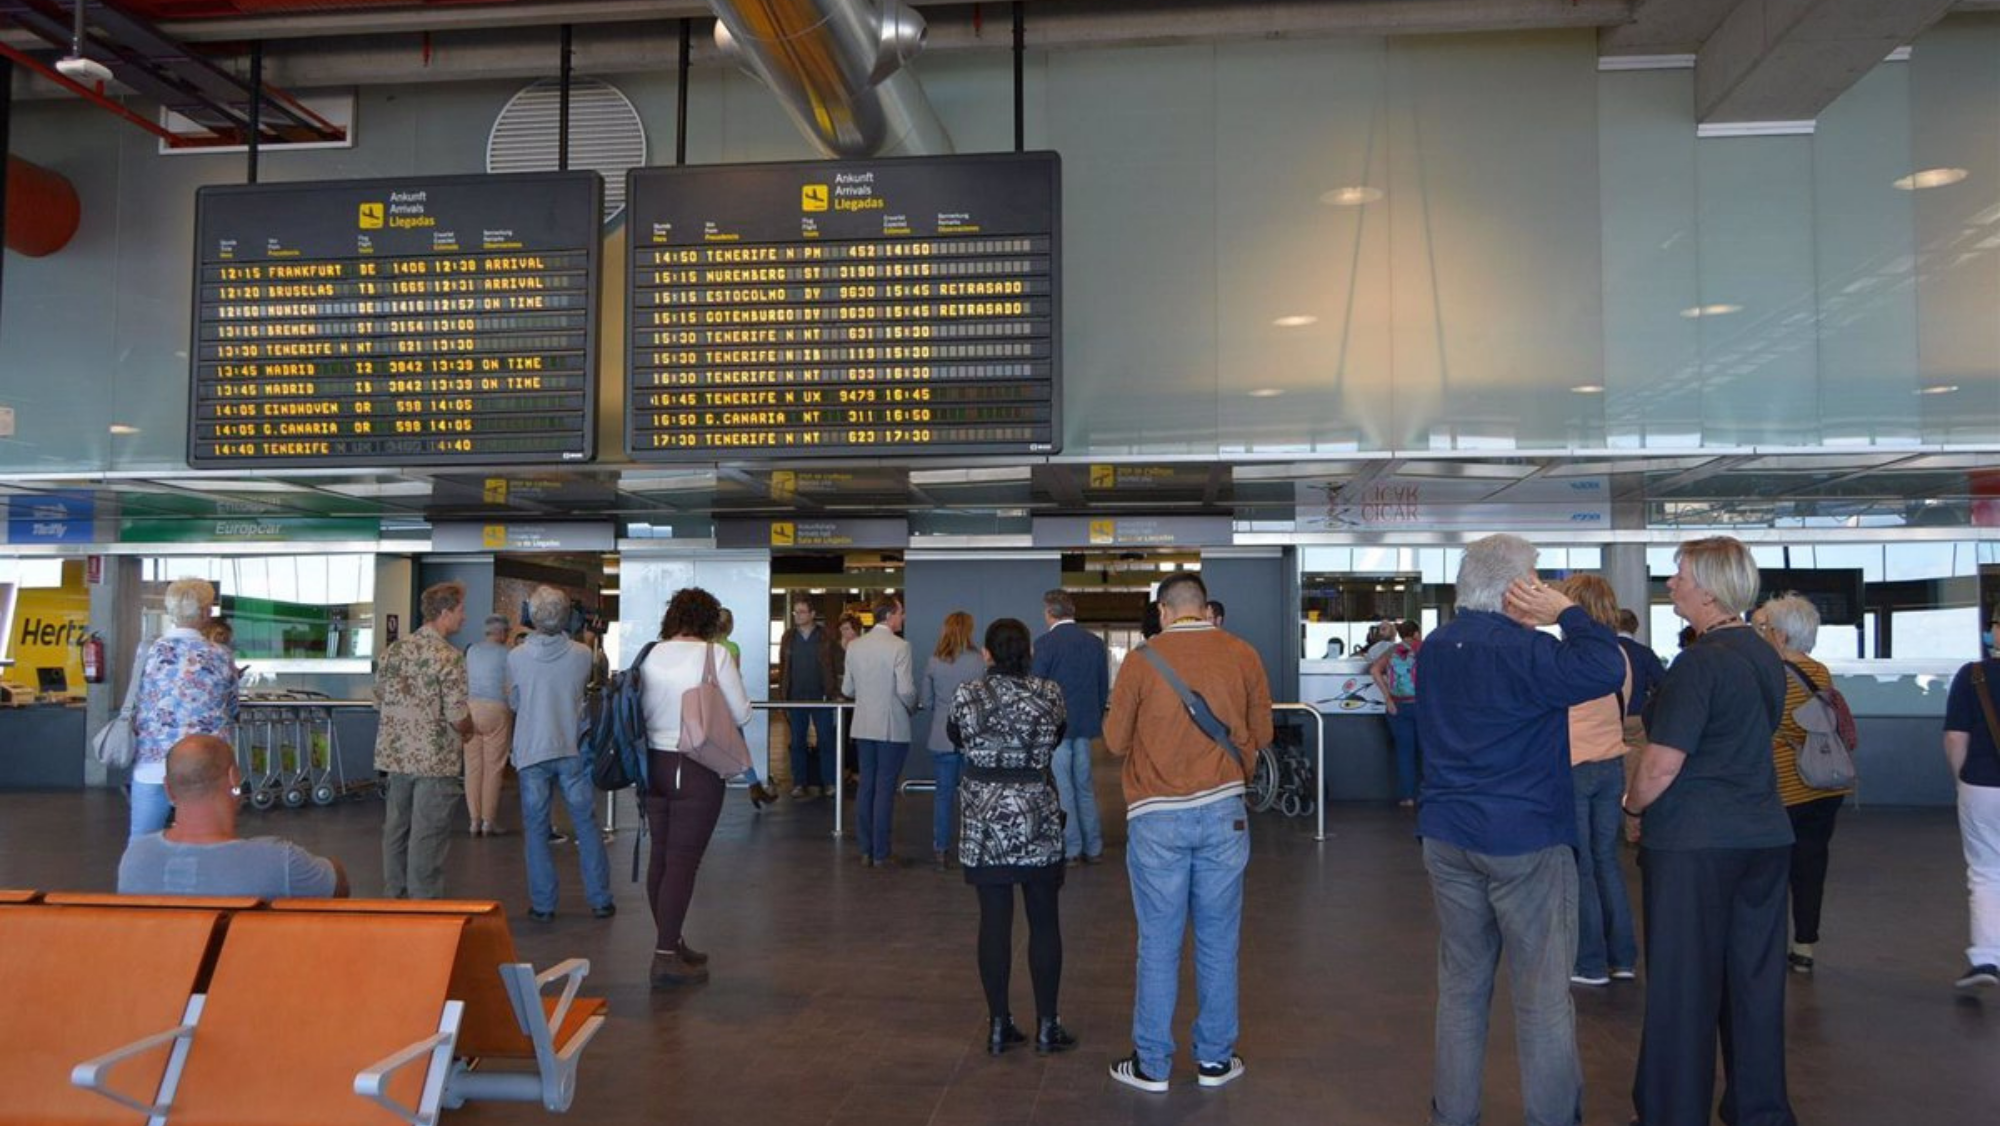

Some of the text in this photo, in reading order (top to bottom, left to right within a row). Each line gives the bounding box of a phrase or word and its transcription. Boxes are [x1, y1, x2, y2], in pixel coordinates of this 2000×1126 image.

[835, 171, 874, 183] Ankunft
[390, 191, 427, 202] Ankunft
[835, 185, 872, 196] Arrivals
[390, 203, 424, 214] Arrivals
[835, 198, 884, 212] Llegadas
[390, 215, 435, 228] Llegadas
[654, 243, 929, 263] 14:50 TENERIFE N PM 452 14:50
[221, 268, 261, 280] 12:15
[269, 264, 341, 278] FRANKFURT
[360, 263, 376, 276] DE
[485, 257, 544, 271] ARRIVAL
[654, 271, 697, 284] 15:15
[706, 268, 786, 282] NUREMBERG
[804, 267, 820, 280] ST
[886, 264, 930, 276] 15:15
[220, 287, 259, 299] 12:20
[269, 284, 334, 298] BRUSELAS
[434, 279, 474, 292] 12:31
[485, 277, 543, 290] ARRIVAL
[654, 292, 697, 304] 15:15
[706, 288, 786, 303] ESTOCOLMO
[804, 287, 821, 300] DY
[886, 284, 930, 297] 15:45
[939, 281, 1022, 295] RETRASADO
[267, 303, 317, 317] MUNICH
[484, 297, 500, 309] ON
[510, 296, 543, 308] TIME
[654, 312, 697, 324] 15:15
[706, 308, 794, 323] GOTEMBURGO
[804, 308, 820, 320] DY
[886, 305, 930, 318] 15:45
[939, 302, 1022, 316] RETRASADO
[267, 323, 316, 336] BREMEN
[358, 321, 373, 333] ST
[654, 325, 930, 344] 15:30 TENERIFE N NT 631 15:30
[218, 339, 474, 357] 13:30 TENERIFE N NT 621 13:30
[654, 352, 697, 365] 15:30
[706, 349, 777, 363] TENERIFE
[786, 349, 794, 361] N
[886, 346, 930, 358] 15:30
[217, 365, 258, 377] 13:45
[265, 363, 315, 376] MADRID
[482, 358, 499, 370] ON
[508, 357, 541, 370] TIME
[654, 372, 697, 385] 16:30
[706, 370, 777, 384] TENERIFE
[786, 369, 795, 382] N
[804, 369, 820, 382] NT
[886, 366, 930, 379] 16:30
[217, 385, 257, 397] 13:45
[265, 382, 314, 395] MADRID
[482, 378, 498, 389] ON
[507, 376, 541, 389] TIME
[653, 388, 930, 405] 16:45 TENERIFE N UX 9479 16:45
[216, 404, 256, 416] 14:05
[264, 402, 339, 415] EINDHOVEN
[355, 401, 371, 414] OR
[431, 399, 472, 411] 14:05
[653, 409, 930, 426] 16:50 G.CANARIA NT 311 16:50
[215, 424, 256, 436] 14:05
[263, 422, 338, 434] G.CANARIA
[430, 418, 472, 431] 14:05
[653, 429, 930, 446] 17:30 TENERIFE N NT 623 17:30
[214, 443, 254, 455] 14:40
[263, 442, 329, 454] TENERIFE
[1361, 503, 1418, 521] CICAR
[215, 521, 281, 537] Europcar
[20, 618, 91, 646] Hertz
